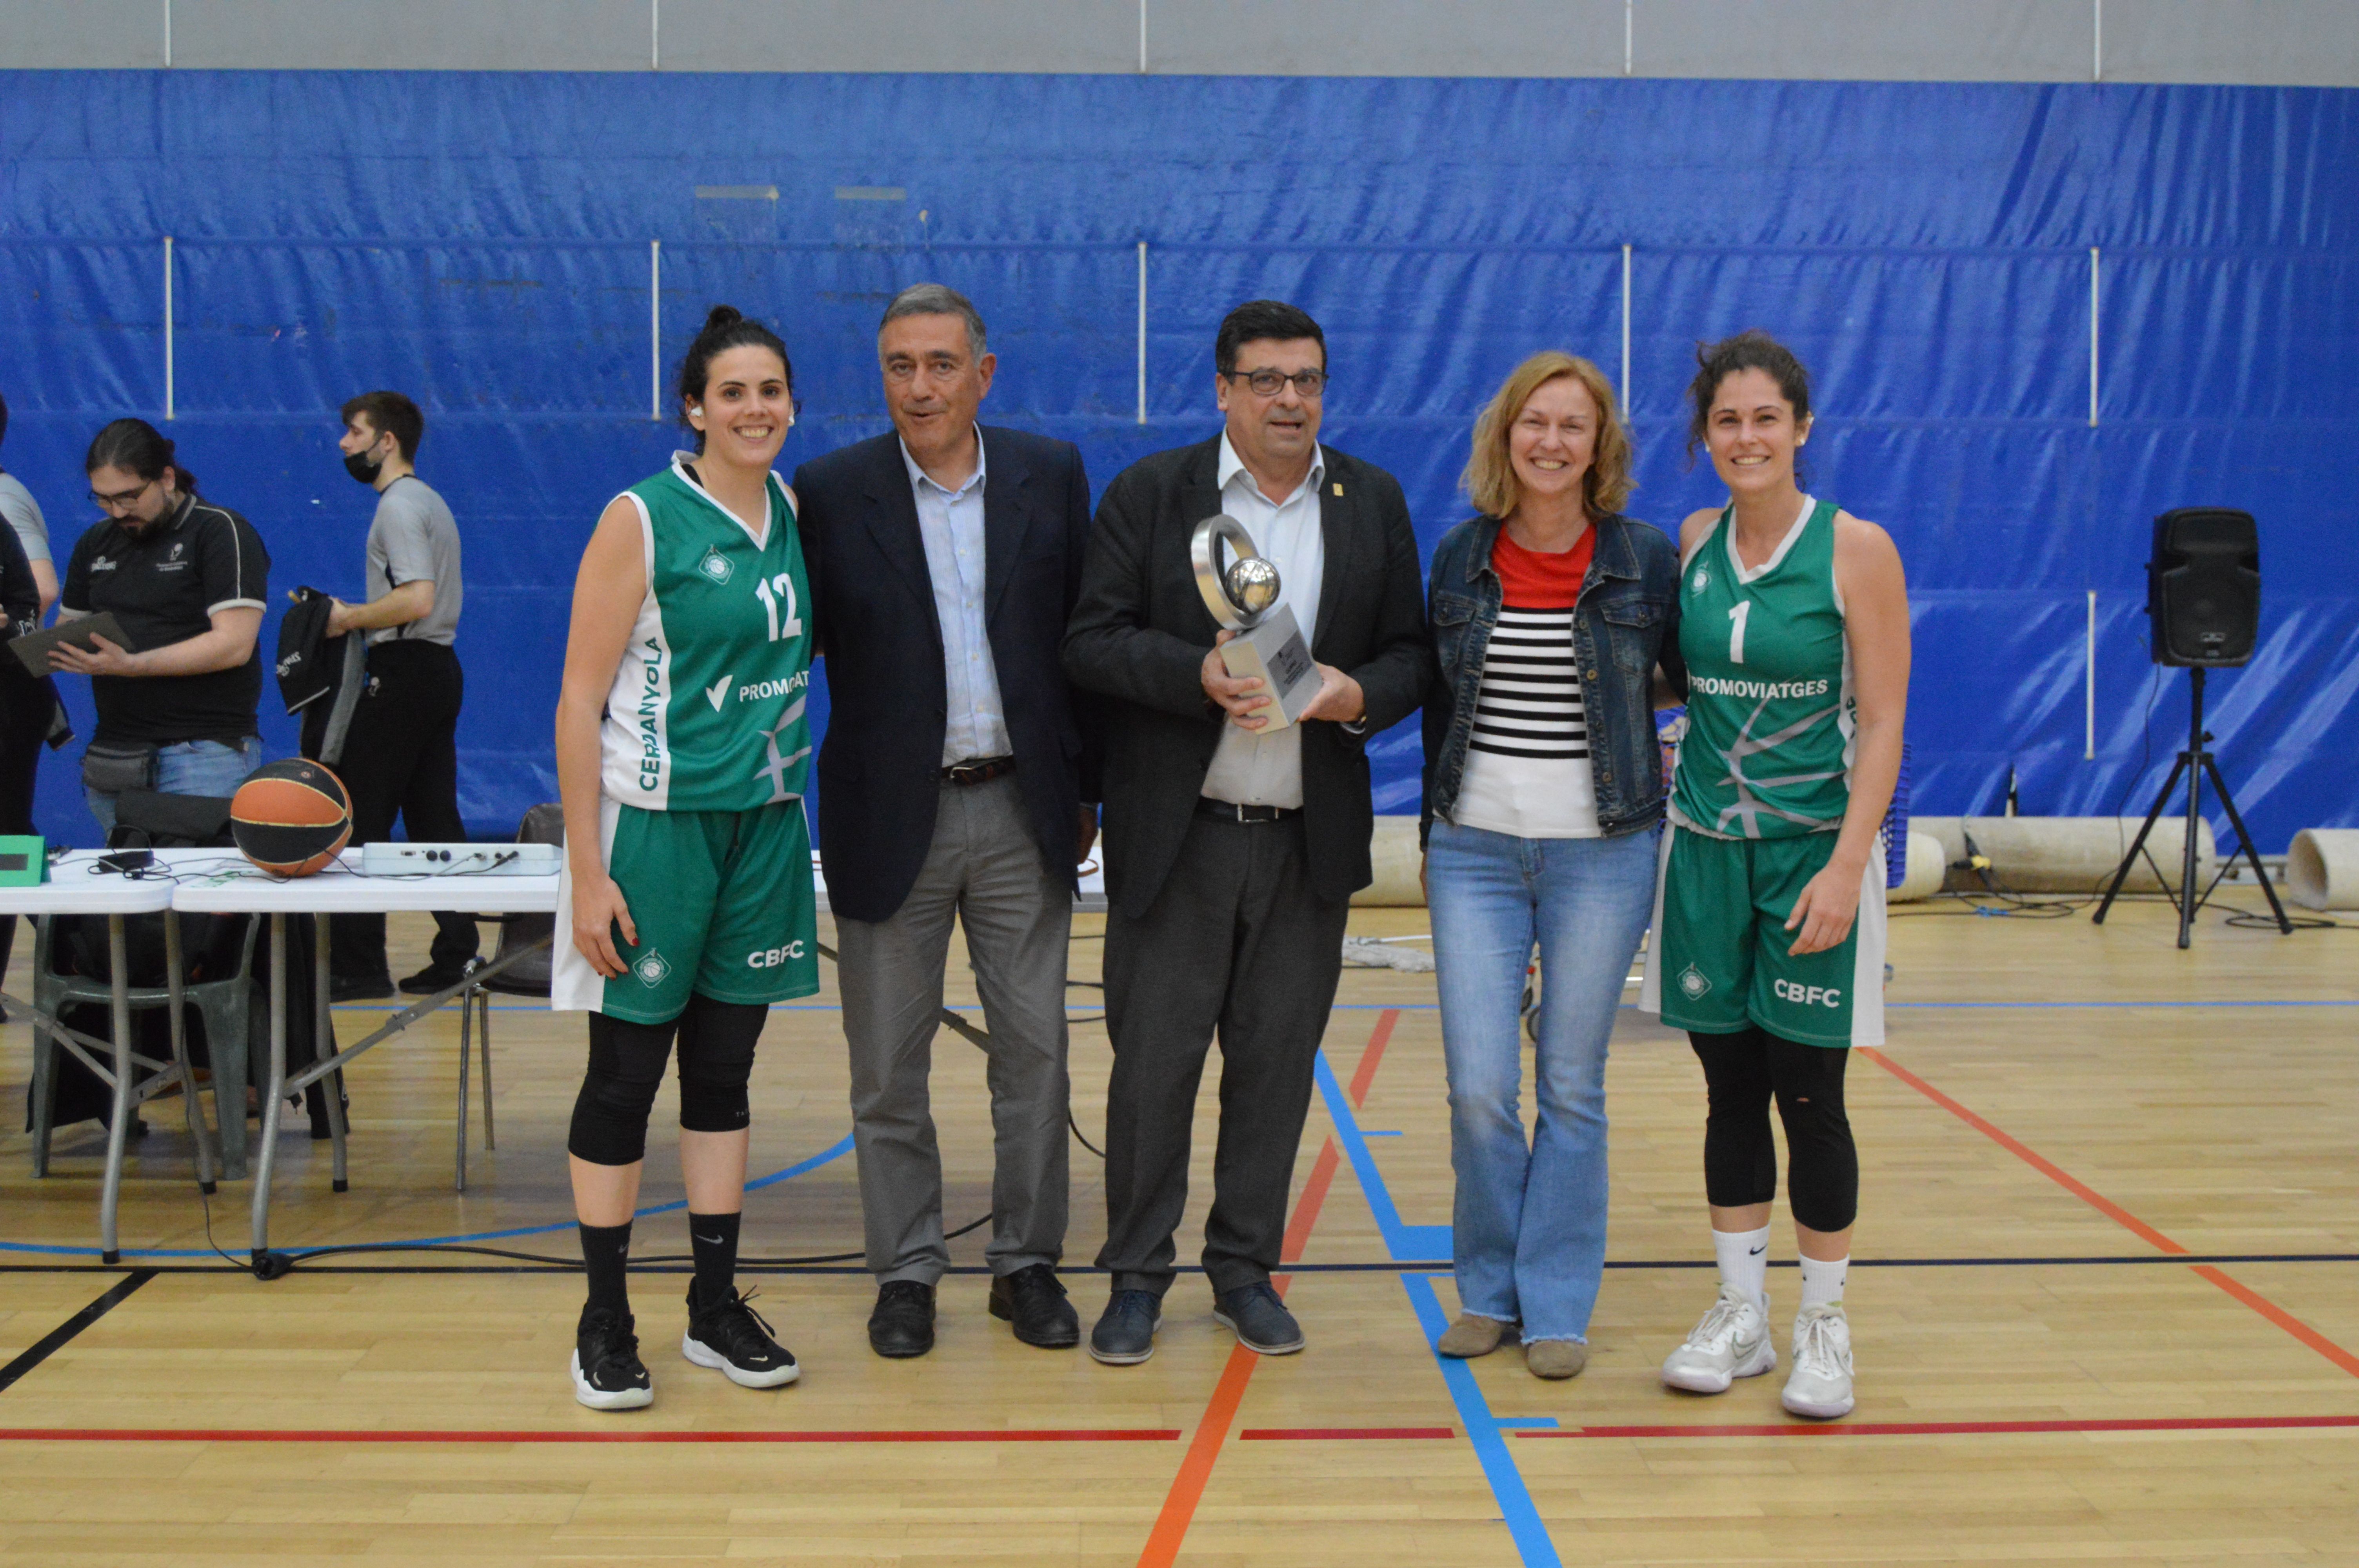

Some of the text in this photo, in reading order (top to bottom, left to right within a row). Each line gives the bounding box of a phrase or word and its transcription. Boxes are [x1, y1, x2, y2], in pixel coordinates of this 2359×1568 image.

[755, 573, 802, 642] 12
[1728, 600, 1750, 664] 1
[1691, 676, 1828, 699] PROMOVIATGES
[638, 637, 663, 791] CERDANYOLA
[747, 940, 804, 968] CBFC
[1774, 978, 1841, 1008] CBFC
